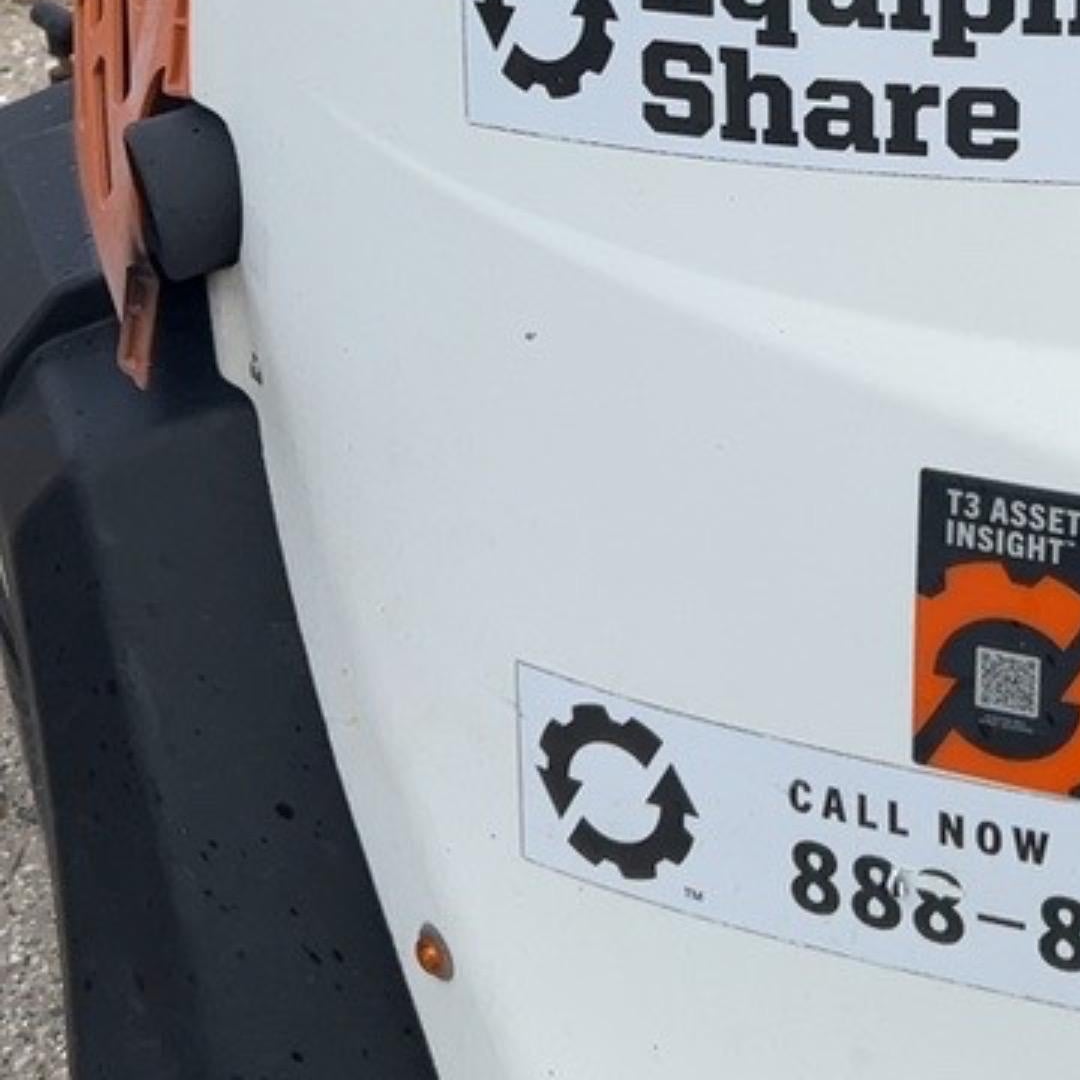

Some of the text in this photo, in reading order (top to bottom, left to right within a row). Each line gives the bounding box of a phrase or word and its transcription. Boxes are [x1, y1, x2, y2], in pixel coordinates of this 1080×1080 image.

[641, 39, 1020, 161] Share
[947, 489, 980, 519] T3
[789, 779, 1050, 866] CALL NOW
